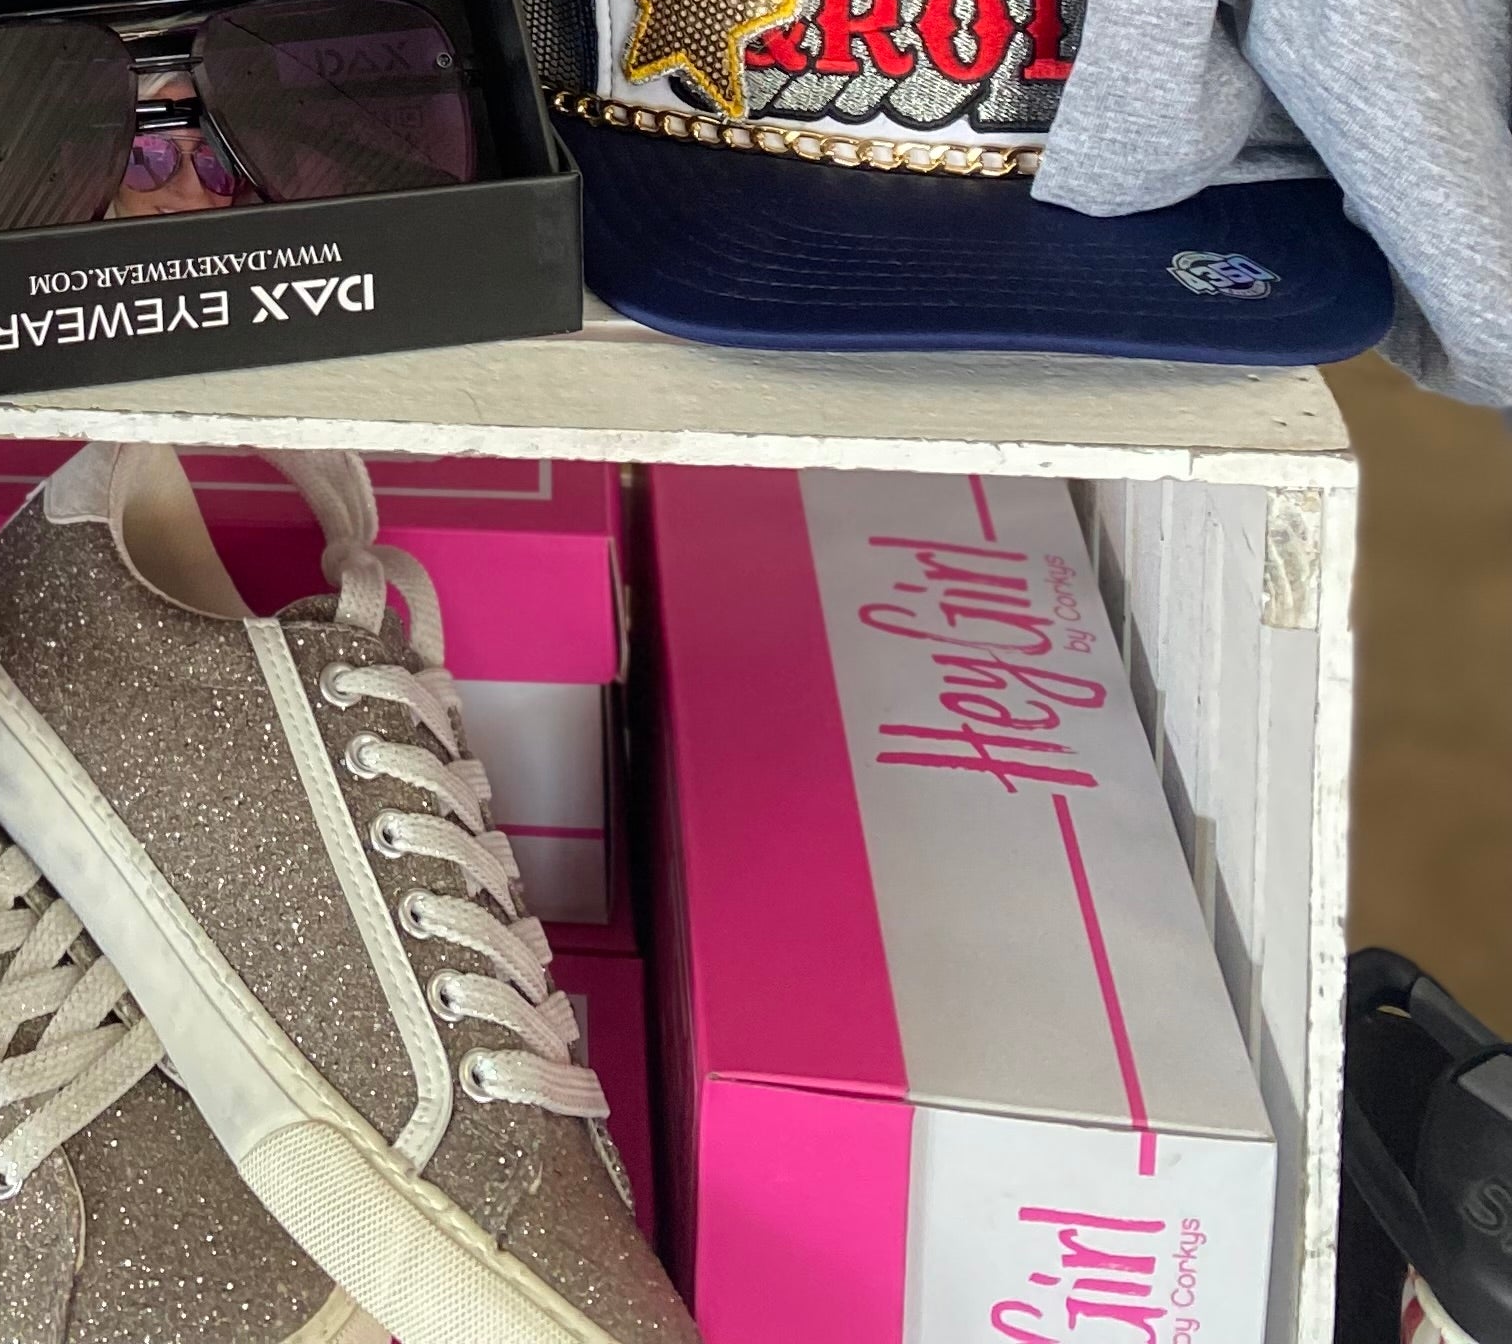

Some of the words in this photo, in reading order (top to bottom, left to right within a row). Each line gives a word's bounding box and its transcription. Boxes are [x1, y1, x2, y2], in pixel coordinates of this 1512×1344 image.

[28, 241, 343, 296] WWW.DAXEYEWEAR.COM
[250, 273, 375, 324] DAX
[1043, 554, 1082, 622] Corkys
[1063, 627, 1097, 654] by
[1170, 1217, 1208, 1308] Corkys
